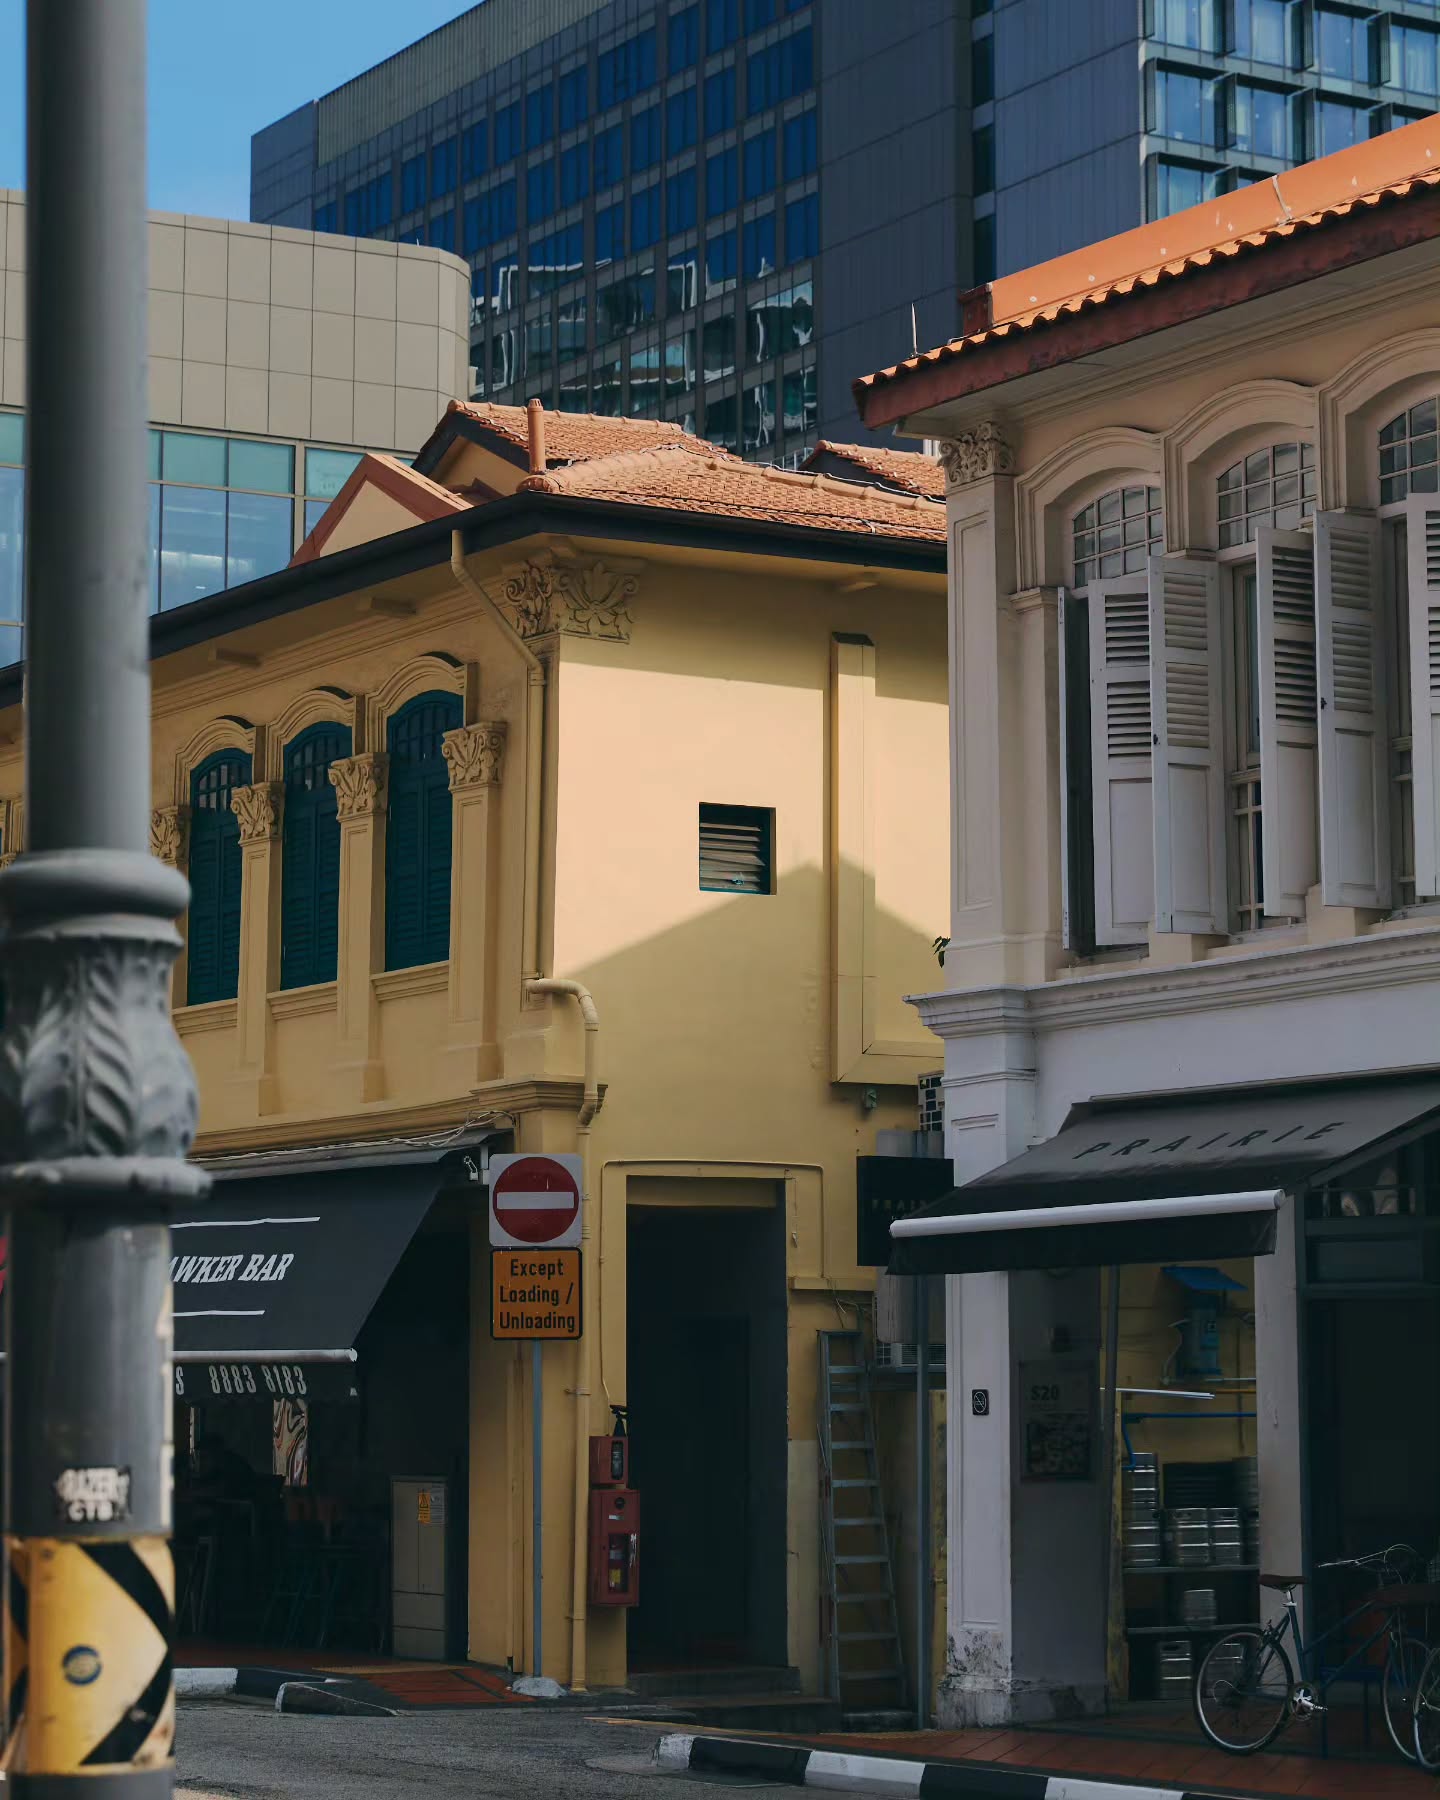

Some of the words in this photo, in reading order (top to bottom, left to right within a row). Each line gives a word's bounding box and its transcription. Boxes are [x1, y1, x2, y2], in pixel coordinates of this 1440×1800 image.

[1072, 1121, 1345, 1160] PRAIRIE
[238, 1253, 295, 1281] BAR
[511, 1258, 564, 1280] Except
[500, 1285, 559, 1307] Loading
[566, 1282, 574, 1305] /
[500, 1311, 575, 1333] Unloading
[208, 1365, 257, 1394] 8883
[261, 1365, 307, 1395] 8183
